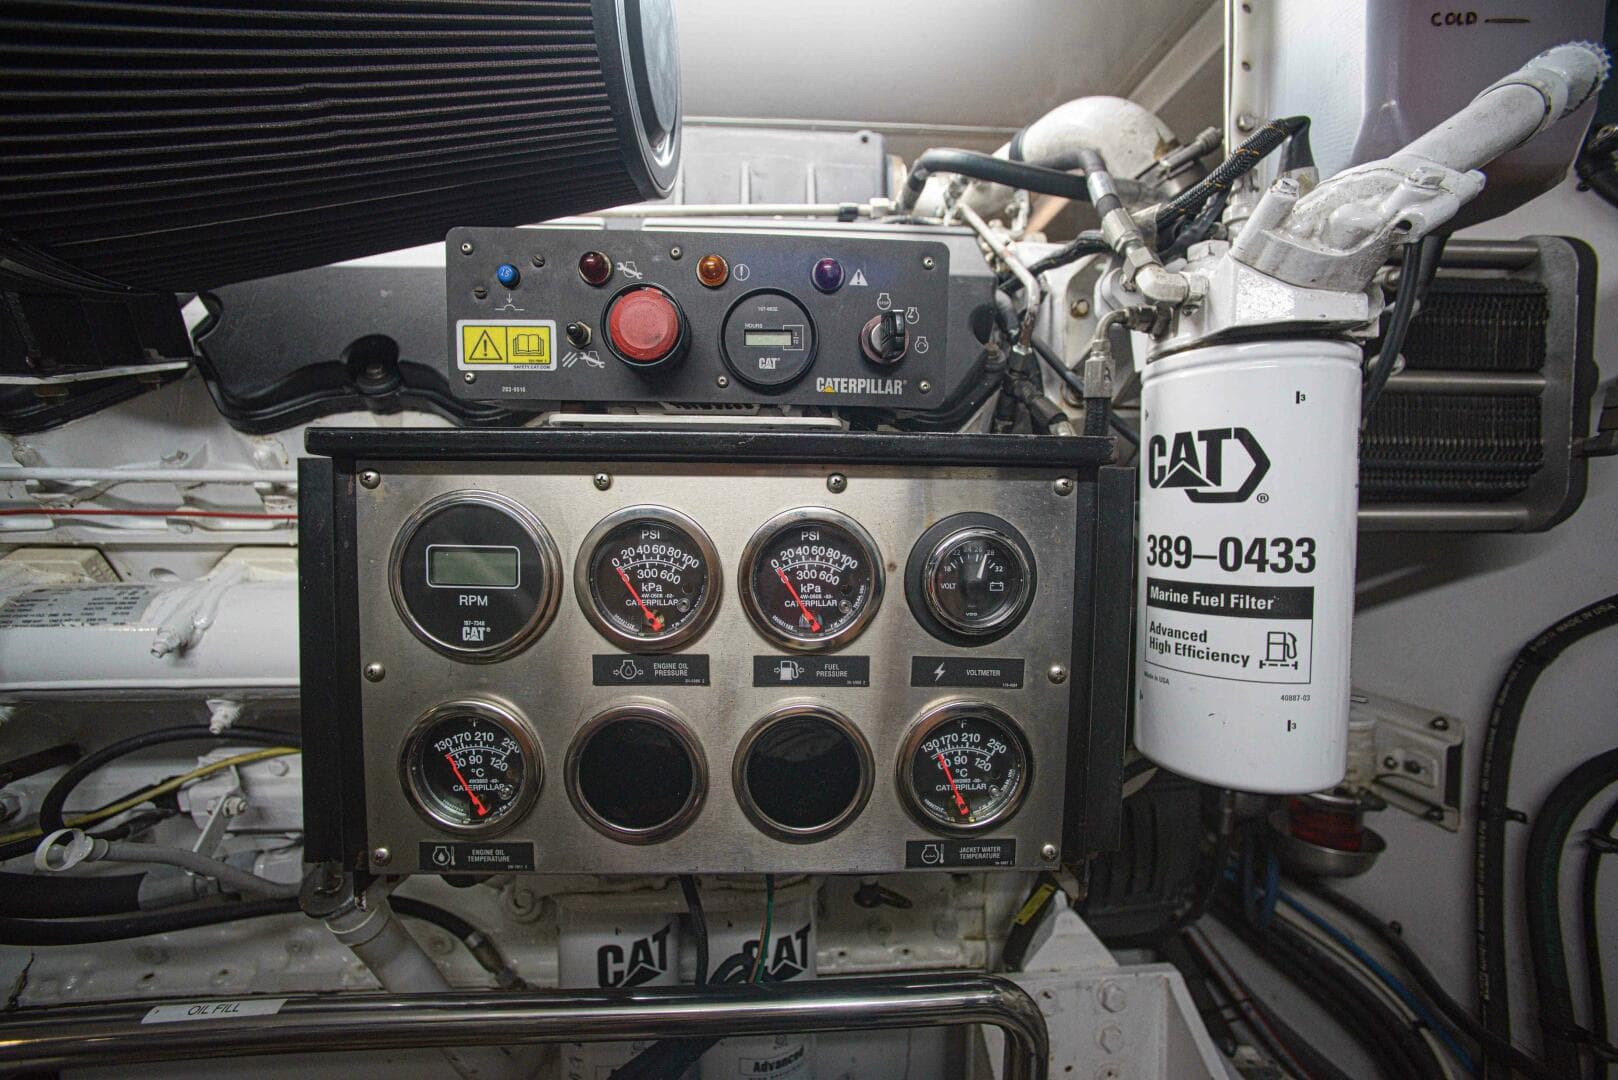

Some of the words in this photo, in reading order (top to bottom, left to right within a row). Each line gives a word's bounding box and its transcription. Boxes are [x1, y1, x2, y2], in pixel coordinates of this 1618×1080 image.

[1431, 12, 1478, 26] COLD
[758, 357, 776, 369] CAT
[816, 377, 902, 394] CATERPILLAR
[1148, 427, 1232, 489] CAT
[641, 530, 660, 540] PSI
[801, 531, 820, 540] PSI
[612, 558, 620, 567] 0
[621, 547, 635, 559] 20
[636, 545, 650, 554] 40
[652, 545, 666, 554] 60
[667, 547, 681, 558] 80
[682, 553, 699, 568] 100
[771, 559, 779, 568] 0
[780, 548, 794, 560] 20
[796, 546, 810, 555] 40
[811, 546, 825, 555] 60
[826, 548, 840, 560] 80
[840, 554, 858, 569] 100
[637, 568, 658, 579] 300
[660, 570, 681, 585] 600
[796, 570, 817, 580] 300
[819, 571, 839, 586] 600
[641, 582, 662, 592] kPa
[800, 584, 821, 593] kPa
[459, 595, 488, 606] RPM
[1150, 586, 1188, 604] Marine
[1192, 591, 1224, 608] Fuel
[1230, 594, 1274, 610] Filter
[462, 627, 486, 641] CAT
[1150, 621, 1208, 643] Advanced
[1150, 637, 1171, 655] High
[1175, 642, 1250, 668] Efficiency
[1159, 677, 1170, 685] USA
[434, 738, 453, 753] 130
[453, 732, 471, 744] 170
[474, 732, 494, 741] 210
[921, 738, 940, 753] 130
[940, 733, 958, 744] 170
[961, 733, 980, 742] 210
[987, 738, 1007, 754] 250
[469, 755, 483, 764] 90
[490, 757, 508, 772] 120
[954, 756, 967, 764] 90
[974, 757, 991, 772] 120
[955, 768, 968, 777] °C
[598, 922, 672, 988] CAT
[188, 1005, 208, 1016] OIL
[212, 1003, 241, 1014] FILL
